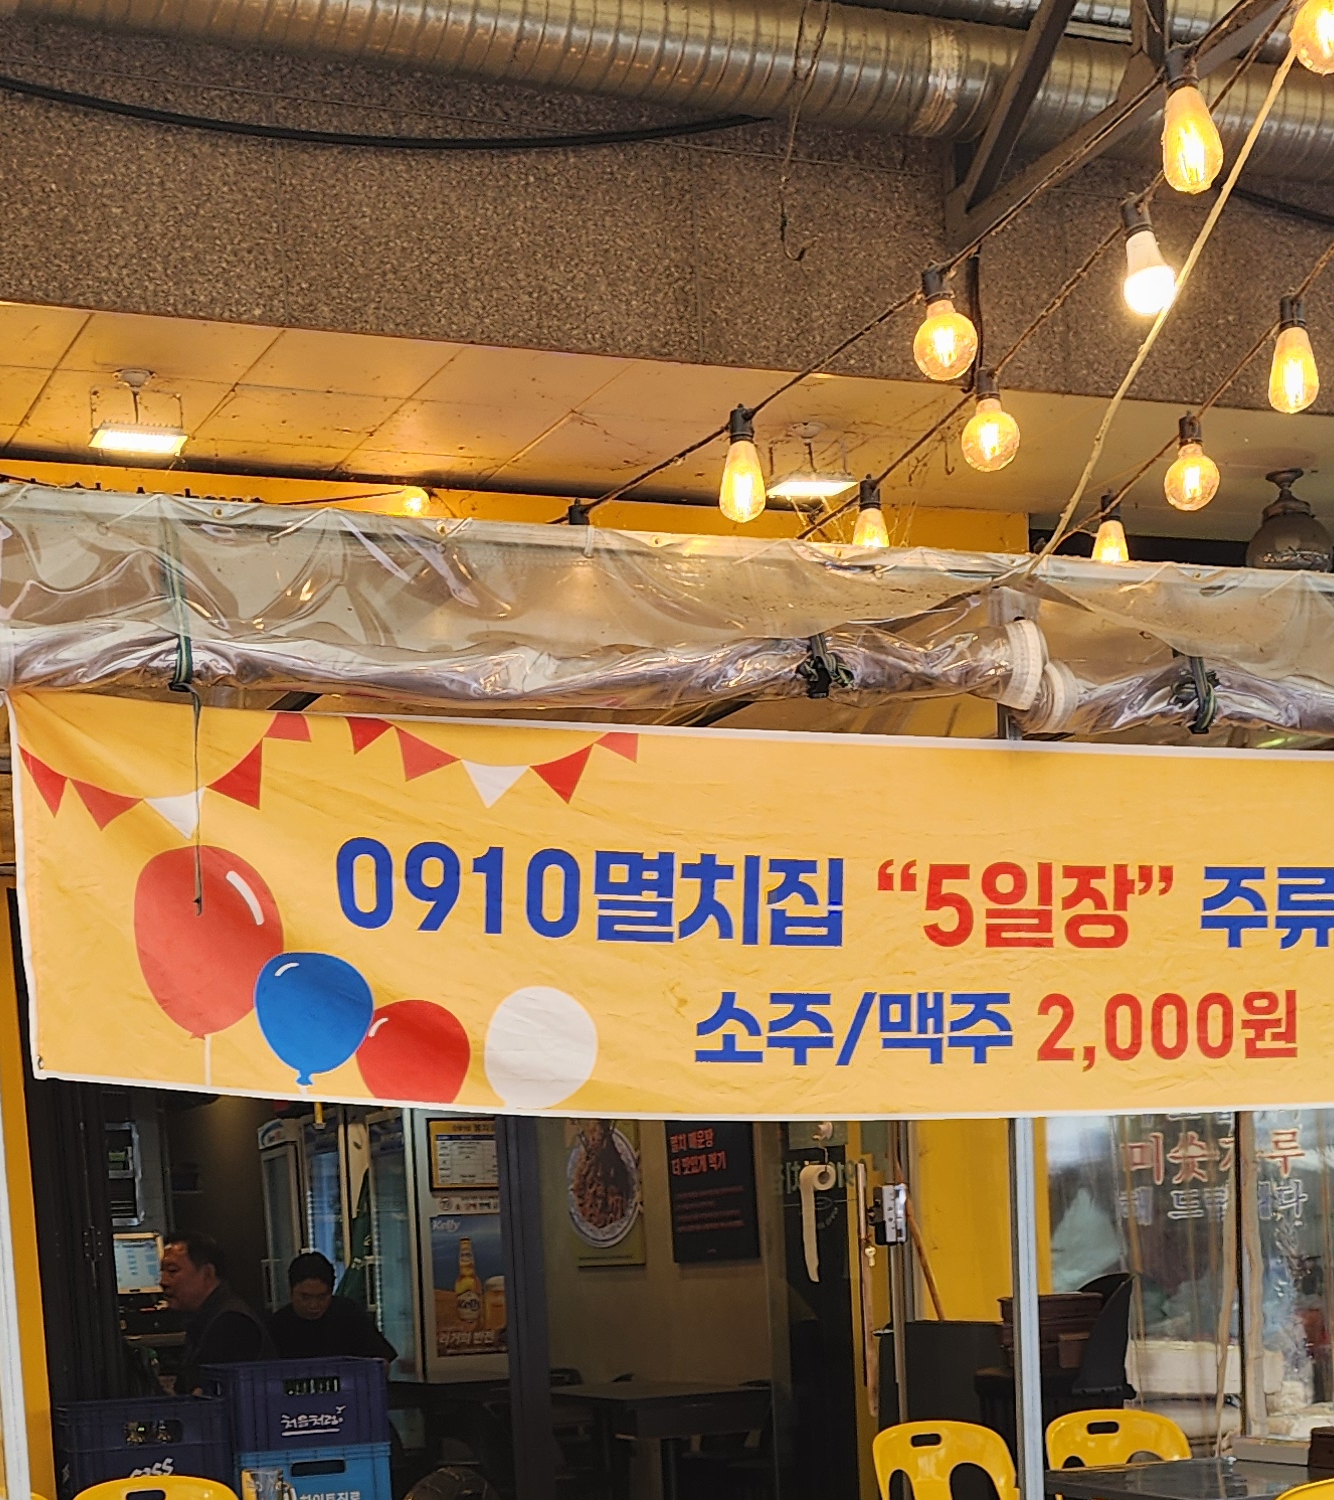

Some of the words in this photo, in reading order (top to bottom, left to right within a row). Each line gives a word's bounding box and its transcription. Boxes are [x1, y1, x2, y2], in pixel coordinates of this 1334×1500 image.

[337, 838, 843, 949] 0910멸치집
[696, 992, 1012, 1066] 소주/맥주
[1038, 989, 1297, 1068] 2,000원
[431, 1218, 461, 1233] Kelly
[280, 1411, 344, 1430] 처음처럼
